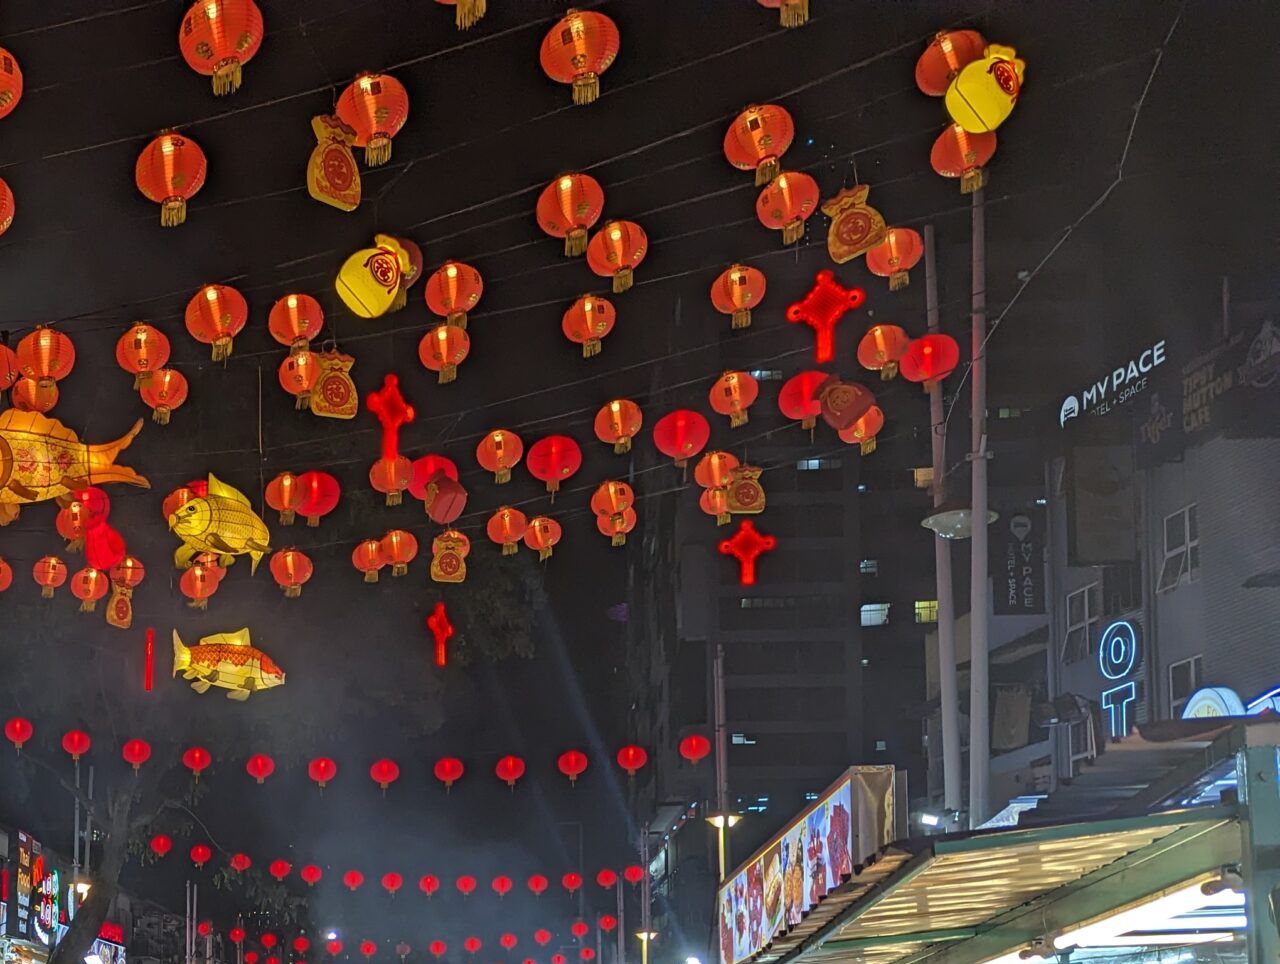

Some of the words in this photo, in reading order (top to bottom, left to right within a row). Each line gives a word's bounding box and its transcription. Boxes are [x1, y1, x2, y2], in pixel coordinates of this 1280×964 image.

[1083, 376, 1109, 411] MY
[1113, 340, 1166, 392] PACE
[1119, 376, 1149, 405] SPACE
